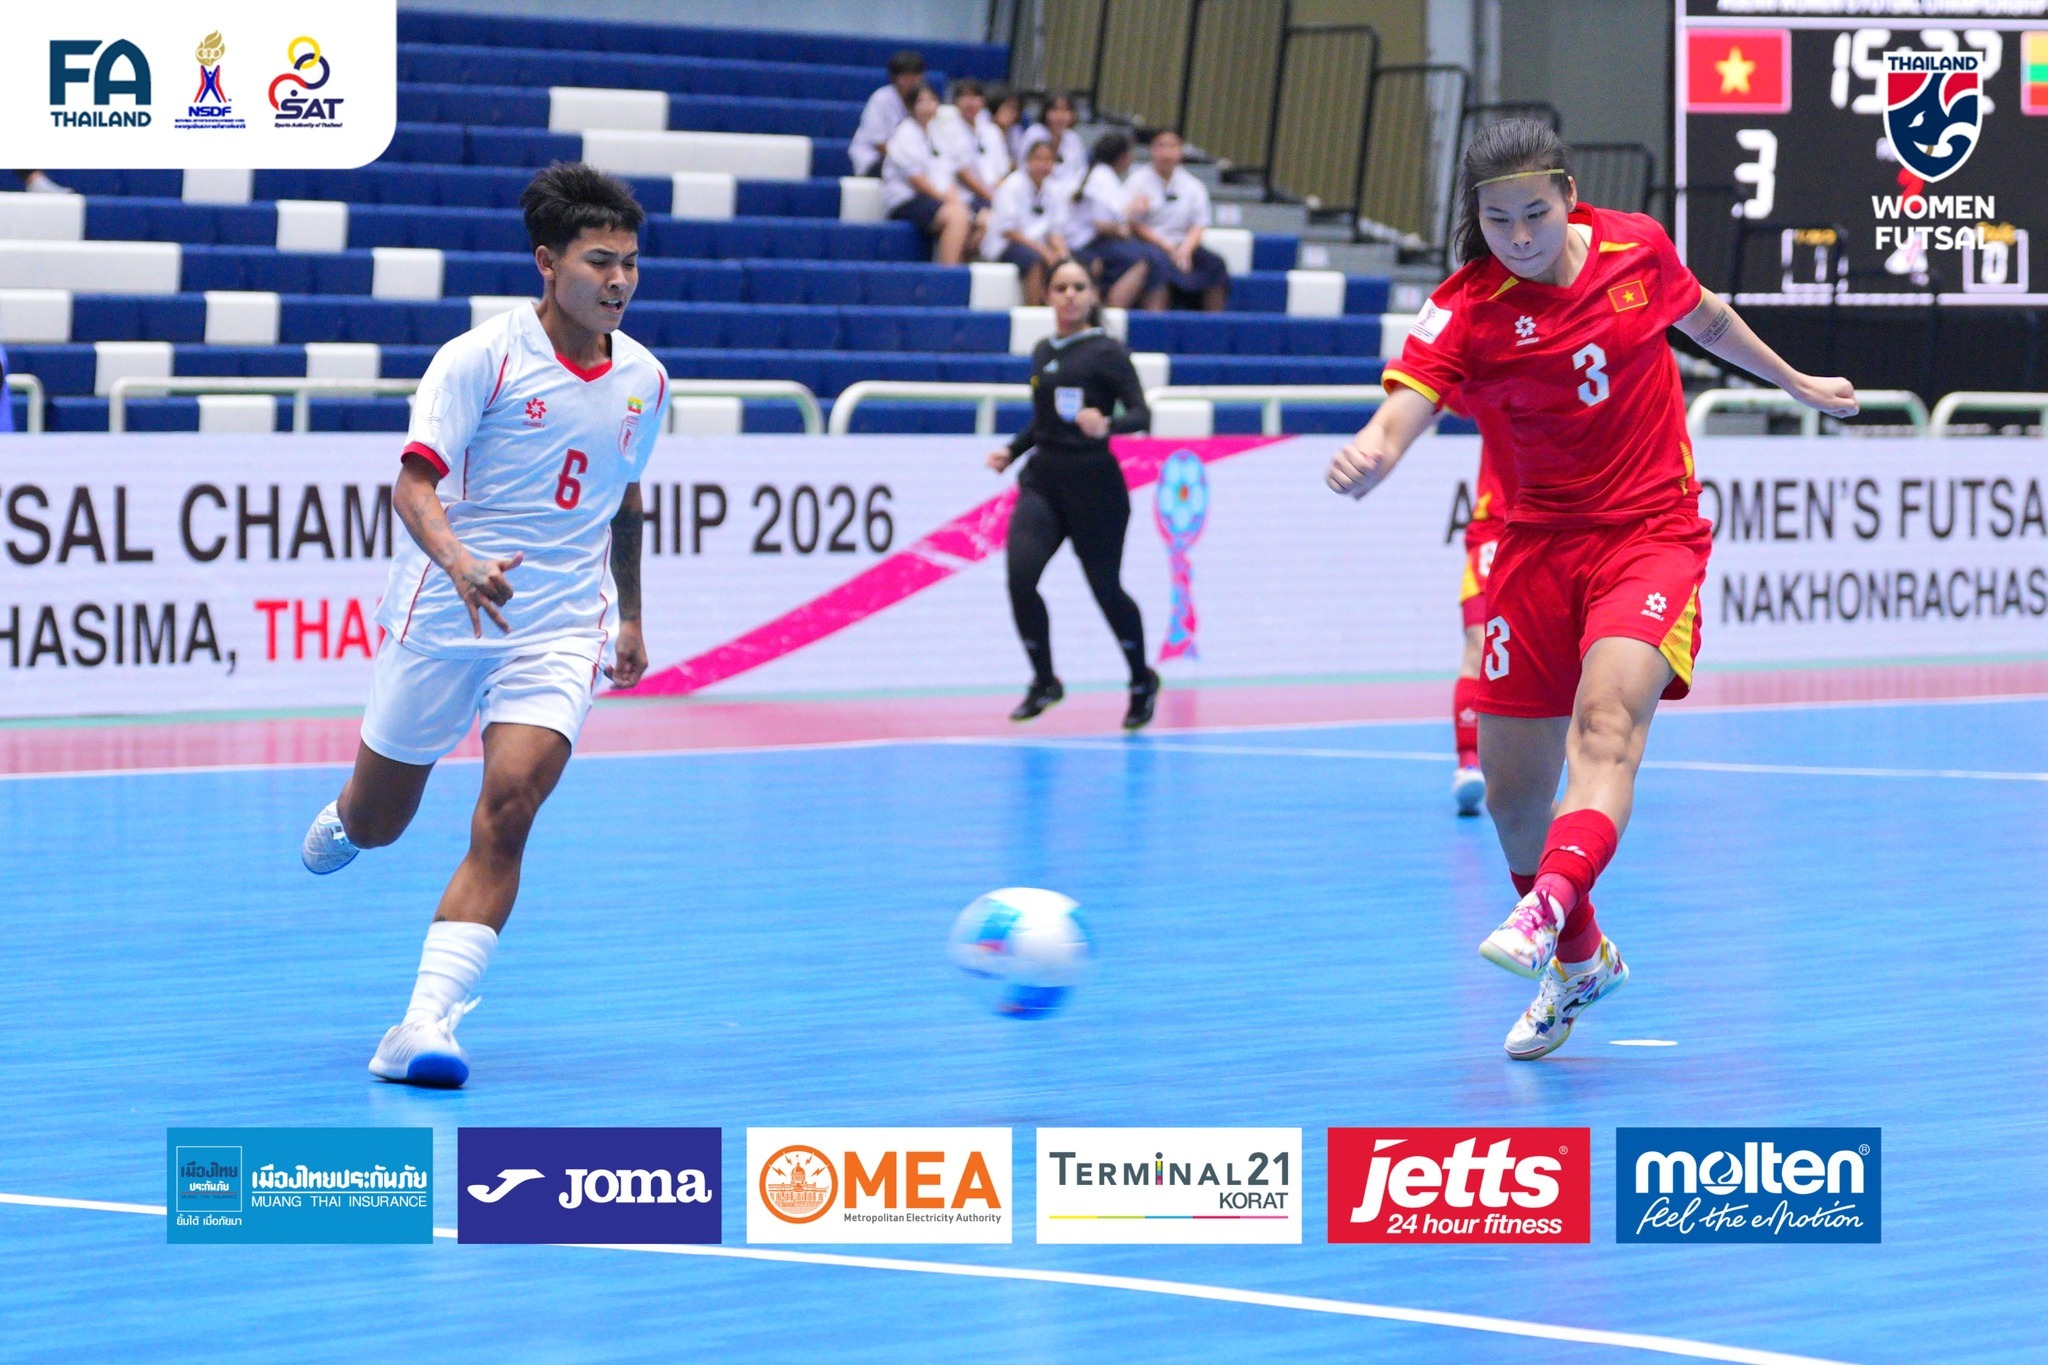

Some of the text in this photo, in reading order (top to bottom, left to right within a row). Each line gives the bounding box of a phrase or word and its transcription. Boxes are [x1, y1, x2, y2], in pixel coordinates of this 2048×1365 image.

[1735, 129, 1777, 219] 3
[1572, 342, 1610, 407] 3
[554, 448, 588, 510] 6
[1700, 478, 1881, 541] OMEN'S
[1898, 478, 2048, 540] FUTSA
[0, 483, 154, 566] SAL
[752, 484, 894, 554] 2026
[1720, 567, 2048, 625] NAKHONRACHAS
[1484, 616, 1511, 681] 3
